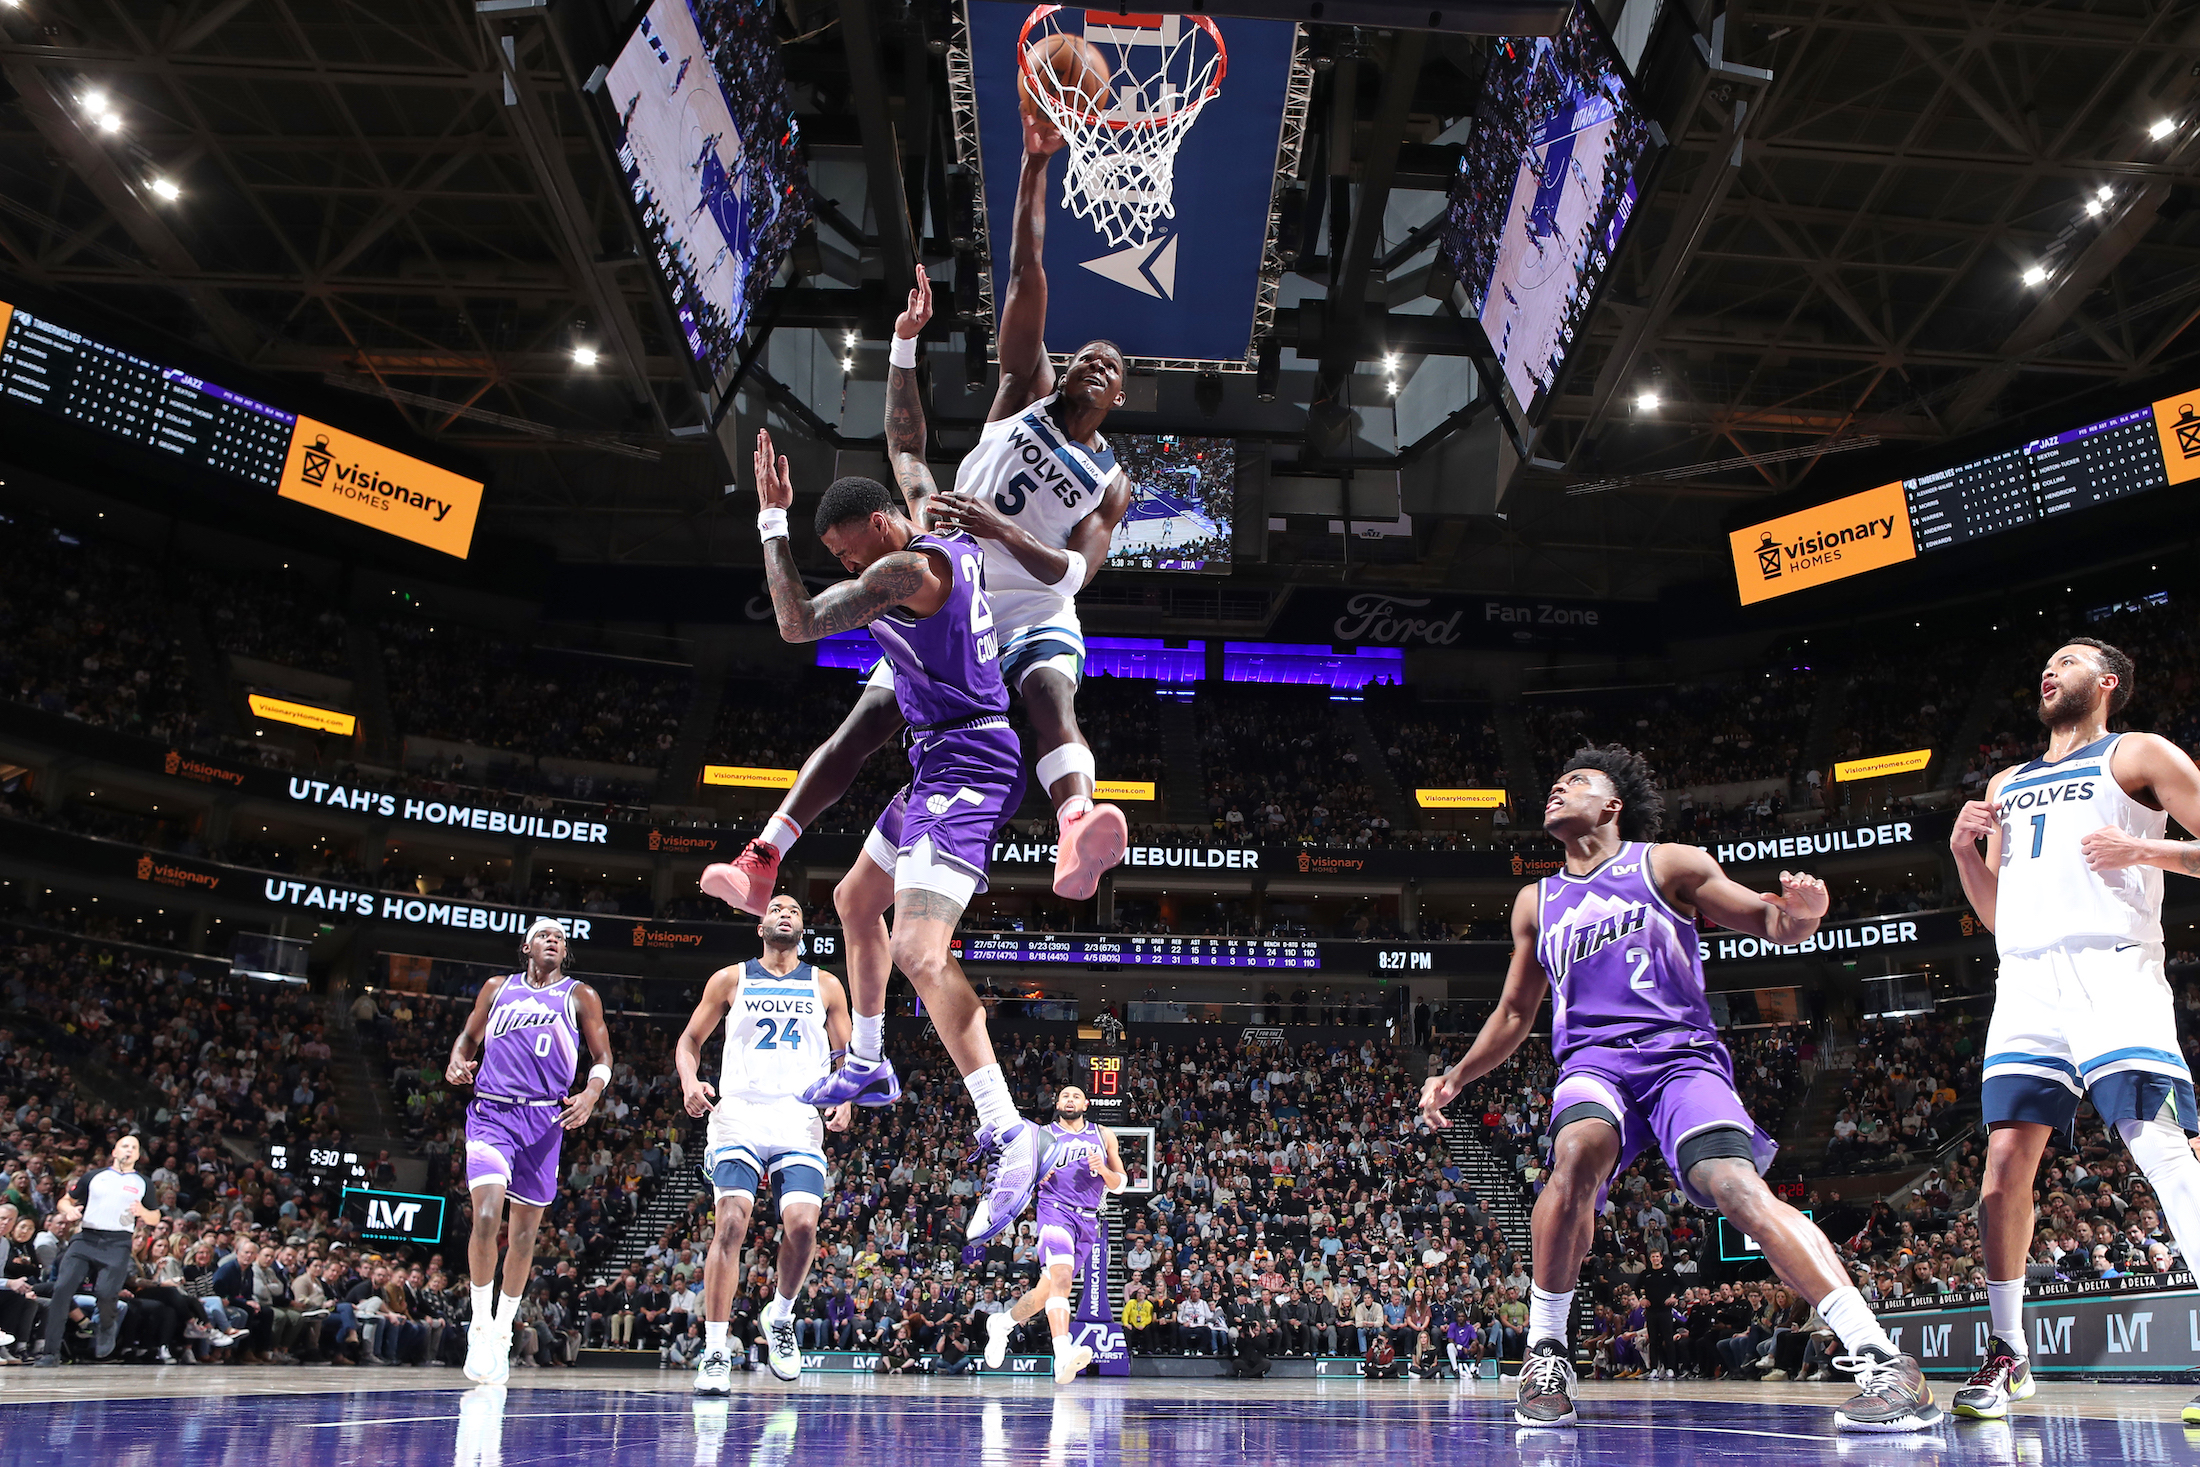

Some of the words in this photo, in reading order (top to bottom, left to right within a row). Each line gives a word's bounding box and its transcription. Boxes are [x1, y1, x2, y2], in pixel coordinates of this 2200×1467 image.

[1617, 192, 1633, 220] UTA
[642, 206, 655, 229] 65
[1595, 254, 1607, 273] 66
[1563, 323, 1574, 344] 65
[180, 375, 204, 390] JAZZ
[2039, 436, 2059, 449] JAZZ
[2036, 450, 2059, 461] SEXTON
[1007, 427, 1082, 509] WOLVES
[2039, 457, 2081, 475] HORTON-TUCKER
[1918, 468, 1955, 486] TIMBERWOLVES
[2042, 475, 2066, 487] COLLINS
[333, 483, 390, 511] HOMES
[336, 464, 452, 522] visionary
[994, 471, 1039, 516] 5
[2044, 486, 2077, 501] HENDRICKS
[1918, 499, 1940, 510] MORRIS
[2047, 502, 2071, 513] GEORGE
[1921, 511, 1944, 522] WARREN
[1784, 515, 1894, 559] visionary
[1923, 523, 1953, 535] ANDERSON
[1926, 536, 1952, 548] EDWARDS
[1142, 560, 1152, 568] 66
[1181, 561, 1196, 569] UTA
[1790, 550, 1842, 573] HOMES
[1334, 594, 1463, 645] Ford
[1486, 603, 1531, 623] Fan
[1538, 605, 1599, 626] Zone
[259, 704, 344, 727] VisionaryHomes.com
[182, 760, 244, 785] visionary
[1844, 757, 1922, 775] VisionaryHomes.com
[713, 772, 788, 783] VisionaryHomes.com
[1425, 795, 1497, 803] VisionaryHomes.com
[2001, 782, 2095, 813] WOLVES
[288, 777, 396, 817] UTAH'S
[403, 800, 608, 844] HOMEBUILDER
[662, 835, 718, 850] visionary
[1717, 822, 1913, 863] HOMEBUILDER
[2030, 814, 2046, 859] 1
[992, 843, 1058, 863] TAH'S
[1120, 847, 1259, 869] EBUILDER
[1311, 857, 1364, 870] visionary
[1524, 858, 1566, 869] visiona
[155, 864, 219, 889] visionary
[1612, 863, 1639, 877] LVT
[265, 878, 374, 916] UTAH'S
[382, 897, 591, 940] HOMEBUILER
[647, 930, 702, 946] visionary
[813, 936, 835, 954] 65
[1546, 903, 1652, 986] UTAH
[974, 941, 997, 949] 27/57
[997, 941, 1018, 950] (47%)
[1028, 942, 1048, 950] 9/23
[1048, 942, 1070, 951] (39%)
[1084, 943, 1099, 951] 2/3
[1100, 943, 1121, 952] (67%)
[1135, 945, 1141, 953] 8
[1171, 946, 1181, 954] 22
[1211, 947, 1217, 955] 5
[1248, 948, 1254, 956] 9
[1266, 948, 1277, 956] 24
[1285, 949, 1296, 957] 110
[1303, 949, 1315, 957] 110
[973, 951, 996, 959] 27/57
[997, 951, 1018, 960] (47%)
[1029, 952, 1046, 960] 8/18
[1047, 952, 1069, 961] (44%)
[1083, 953, 1098, 961] 4/5
[1099, 953, 1121, 962] (80%)
[1171, 956, 1181, 964] 31
[1211, 957, 1217, 965] 6
[1230, 957, 1236, 965] 3
[1247, 958, 1256, 966] 10
[1285, 959, 1296, 967] 110
[1303, 959, 1315, 967] 110
[1379, 951, 1407, 969] 8:27
[1410, 952, 1432, 970] PM
[1626, 947, 1654, 990] 2
[745, 1000, 813, 1014] WOLVES
[493, 1006, 562, 1038] UTAH
[755, 1018, 801, 1050] 24
[535, 1033, 552, 1057] 0
[1090, 1057, 1120, 1071] 5:30
[1093, 1071, 1117, 1095] 19
[1090, 1099, 1122, 1107] TISSOT
[271, 1157, 287, 1169] 65
[310, 1149, 340, 1167] 5:30
[351, 1165, 365, 1176] 66
[366, 1199, 422, 1232] LVT
[1092, 1243, 1100, 1270] FIRST
[1090, 1271, 1100, 1318] AMERICA
[1889, 1300, 1905, 1308] DELTA
[1916, 1297, 1933, 1305] DELTA
[1944, 1294, 1963, 1303] DELTA
[1975, 1291, 1989, 1300] DEL
[2046, 1283, 2069, 1295] DELTA
[2084, 1280, 2110, 1292] DELTA
[2126, 1275, 2156, 1288] DELTA
[2175, 1272, 2194, 1284] DEL
[1922, 1324, 1952, 1358] LVT
[2036, 1316, 2076, 1355] LVT
[2107, 1312, 2153, 1354] LVT
[801, 1356, 825, 1368] LVT
[853, 1356, 879, 1369] LVT
[1012, 1358, 1037, 1371] LVT
[1100, 1352, 1124, 1360] FIRST
